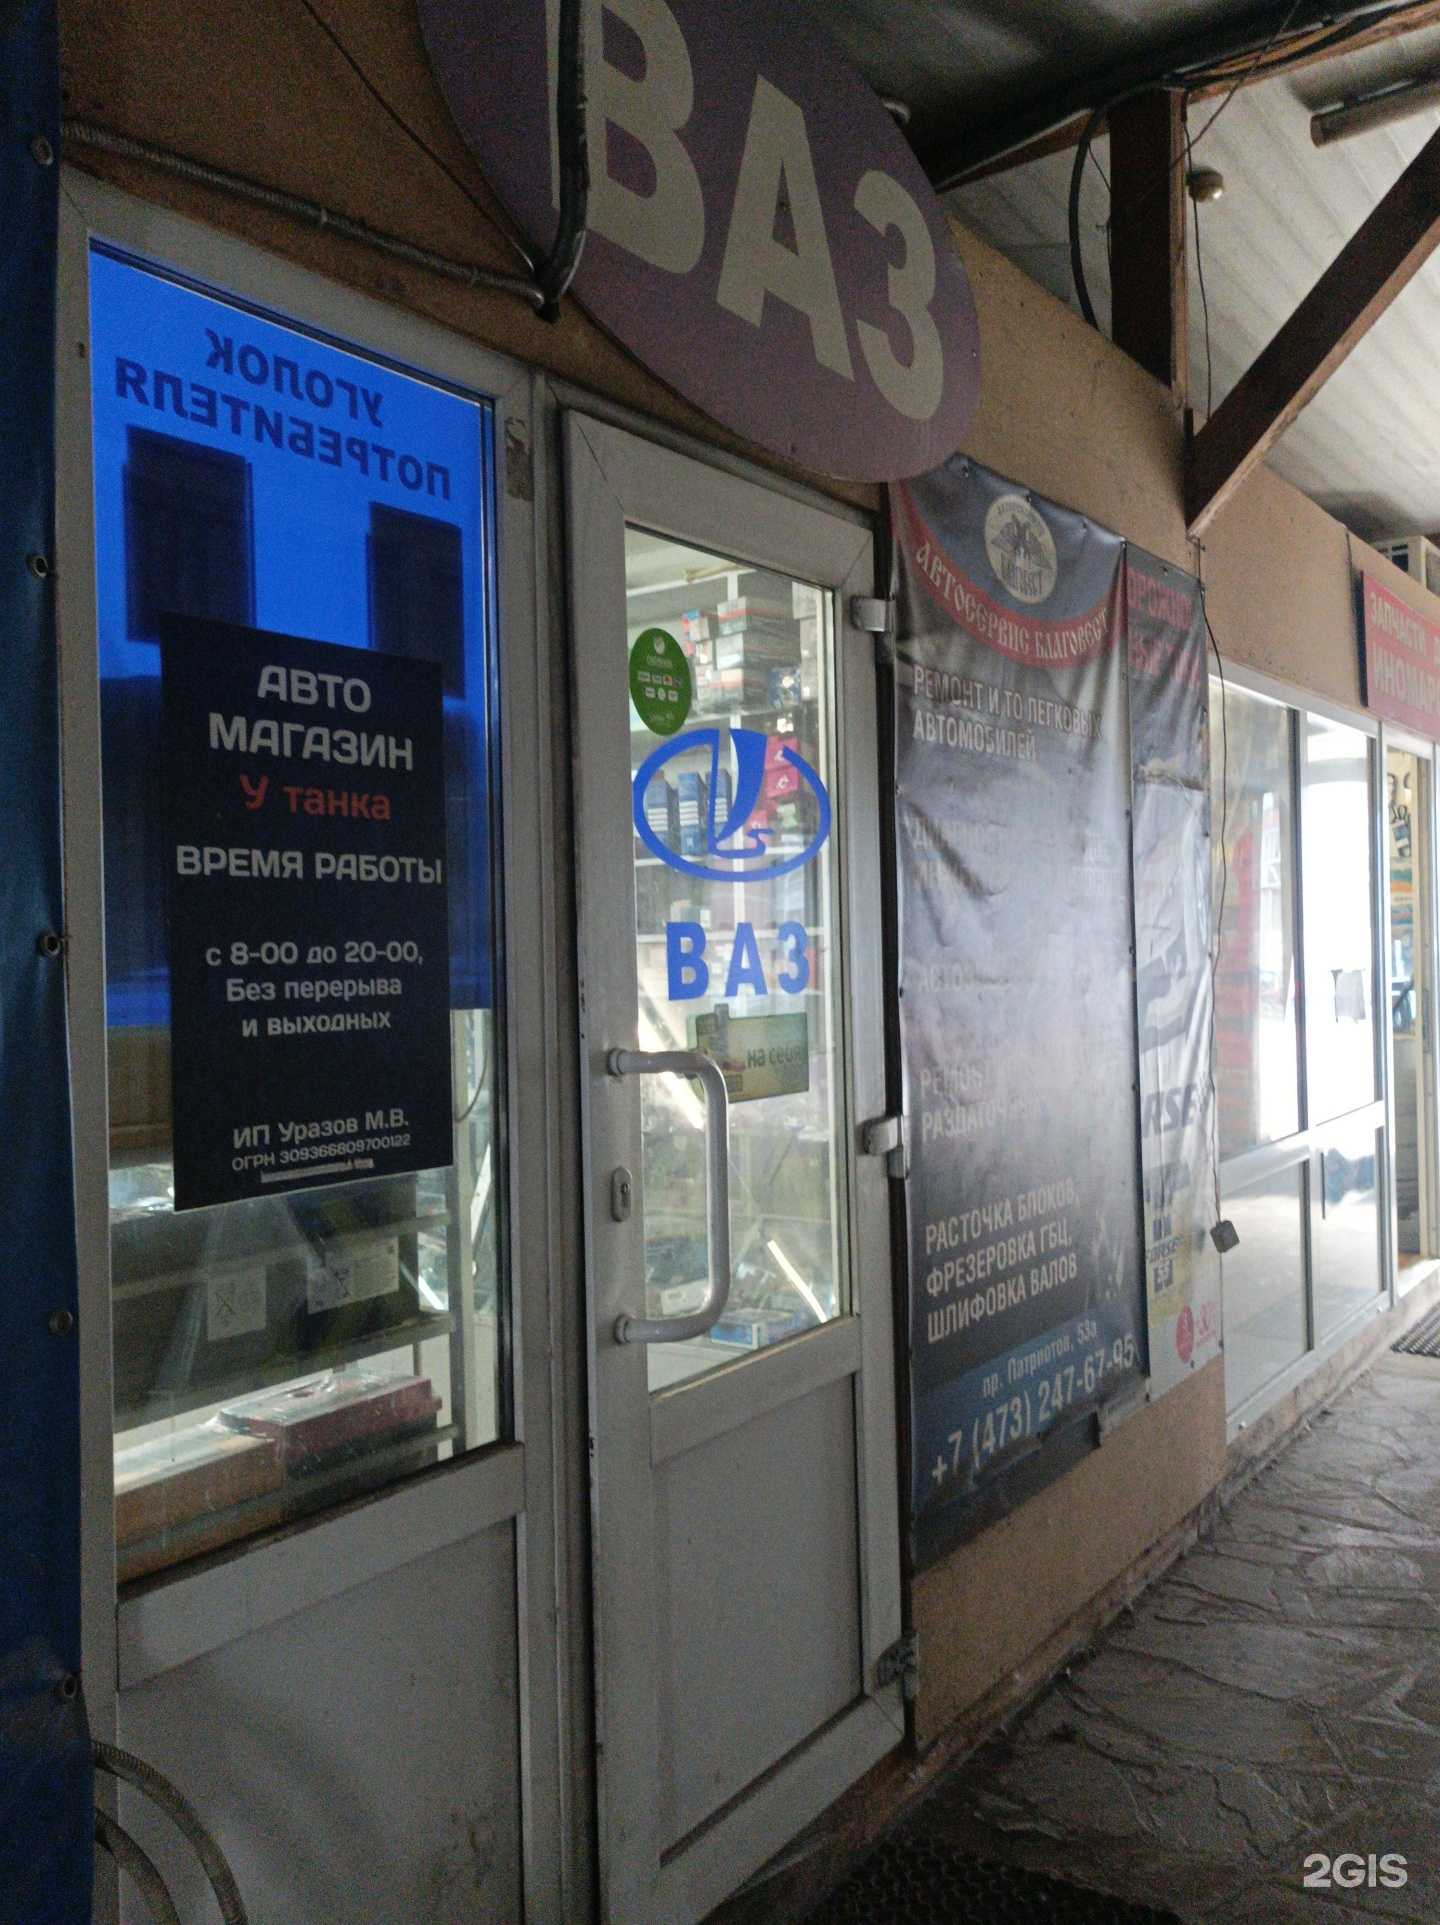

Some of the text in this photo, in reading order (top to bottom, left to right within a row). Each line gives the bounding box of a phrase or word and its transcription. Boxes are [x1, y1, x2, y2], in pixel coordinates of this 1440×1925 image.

[545, 0, 944, 421] ВАЗ
[257, 664, 372, 713] АВТО
[913, 665, 1101, 737] РЕМОНТ И ТО ЛЕГКОВЫХ
[208, 712, 413, 771] МАГАЗИН
[912, 709, 1036, 761] АВТОМОБИЛЕЙ
[239, 773, 391, 821] У танка
[176, 845, 442, 884] ВРЕМЯ РАБОТЫ
[205, 940, 423, 966] с 8-00 до 20-00,
[666, 921, 810, 1000] ВАЗ
[226, 978, 402, 1002] Без перерыва
[242, 1011, 392, 1037] и выходных
[232, 1109, 409, 1149] ИП Уразов М.В.
[231, 1150, 275, 1171] ОГРН
[925, 1198, 1013, 1255] РАСТОЧКА
[926, 1230, 1036, 1298] ФРЕЗЕРОВКА
[927, 1252, 1077, 1344] ШЛИФОВКА ВАЛОВ
[932, 1333, 1135, 1485] +7 (473) 247-67-95
